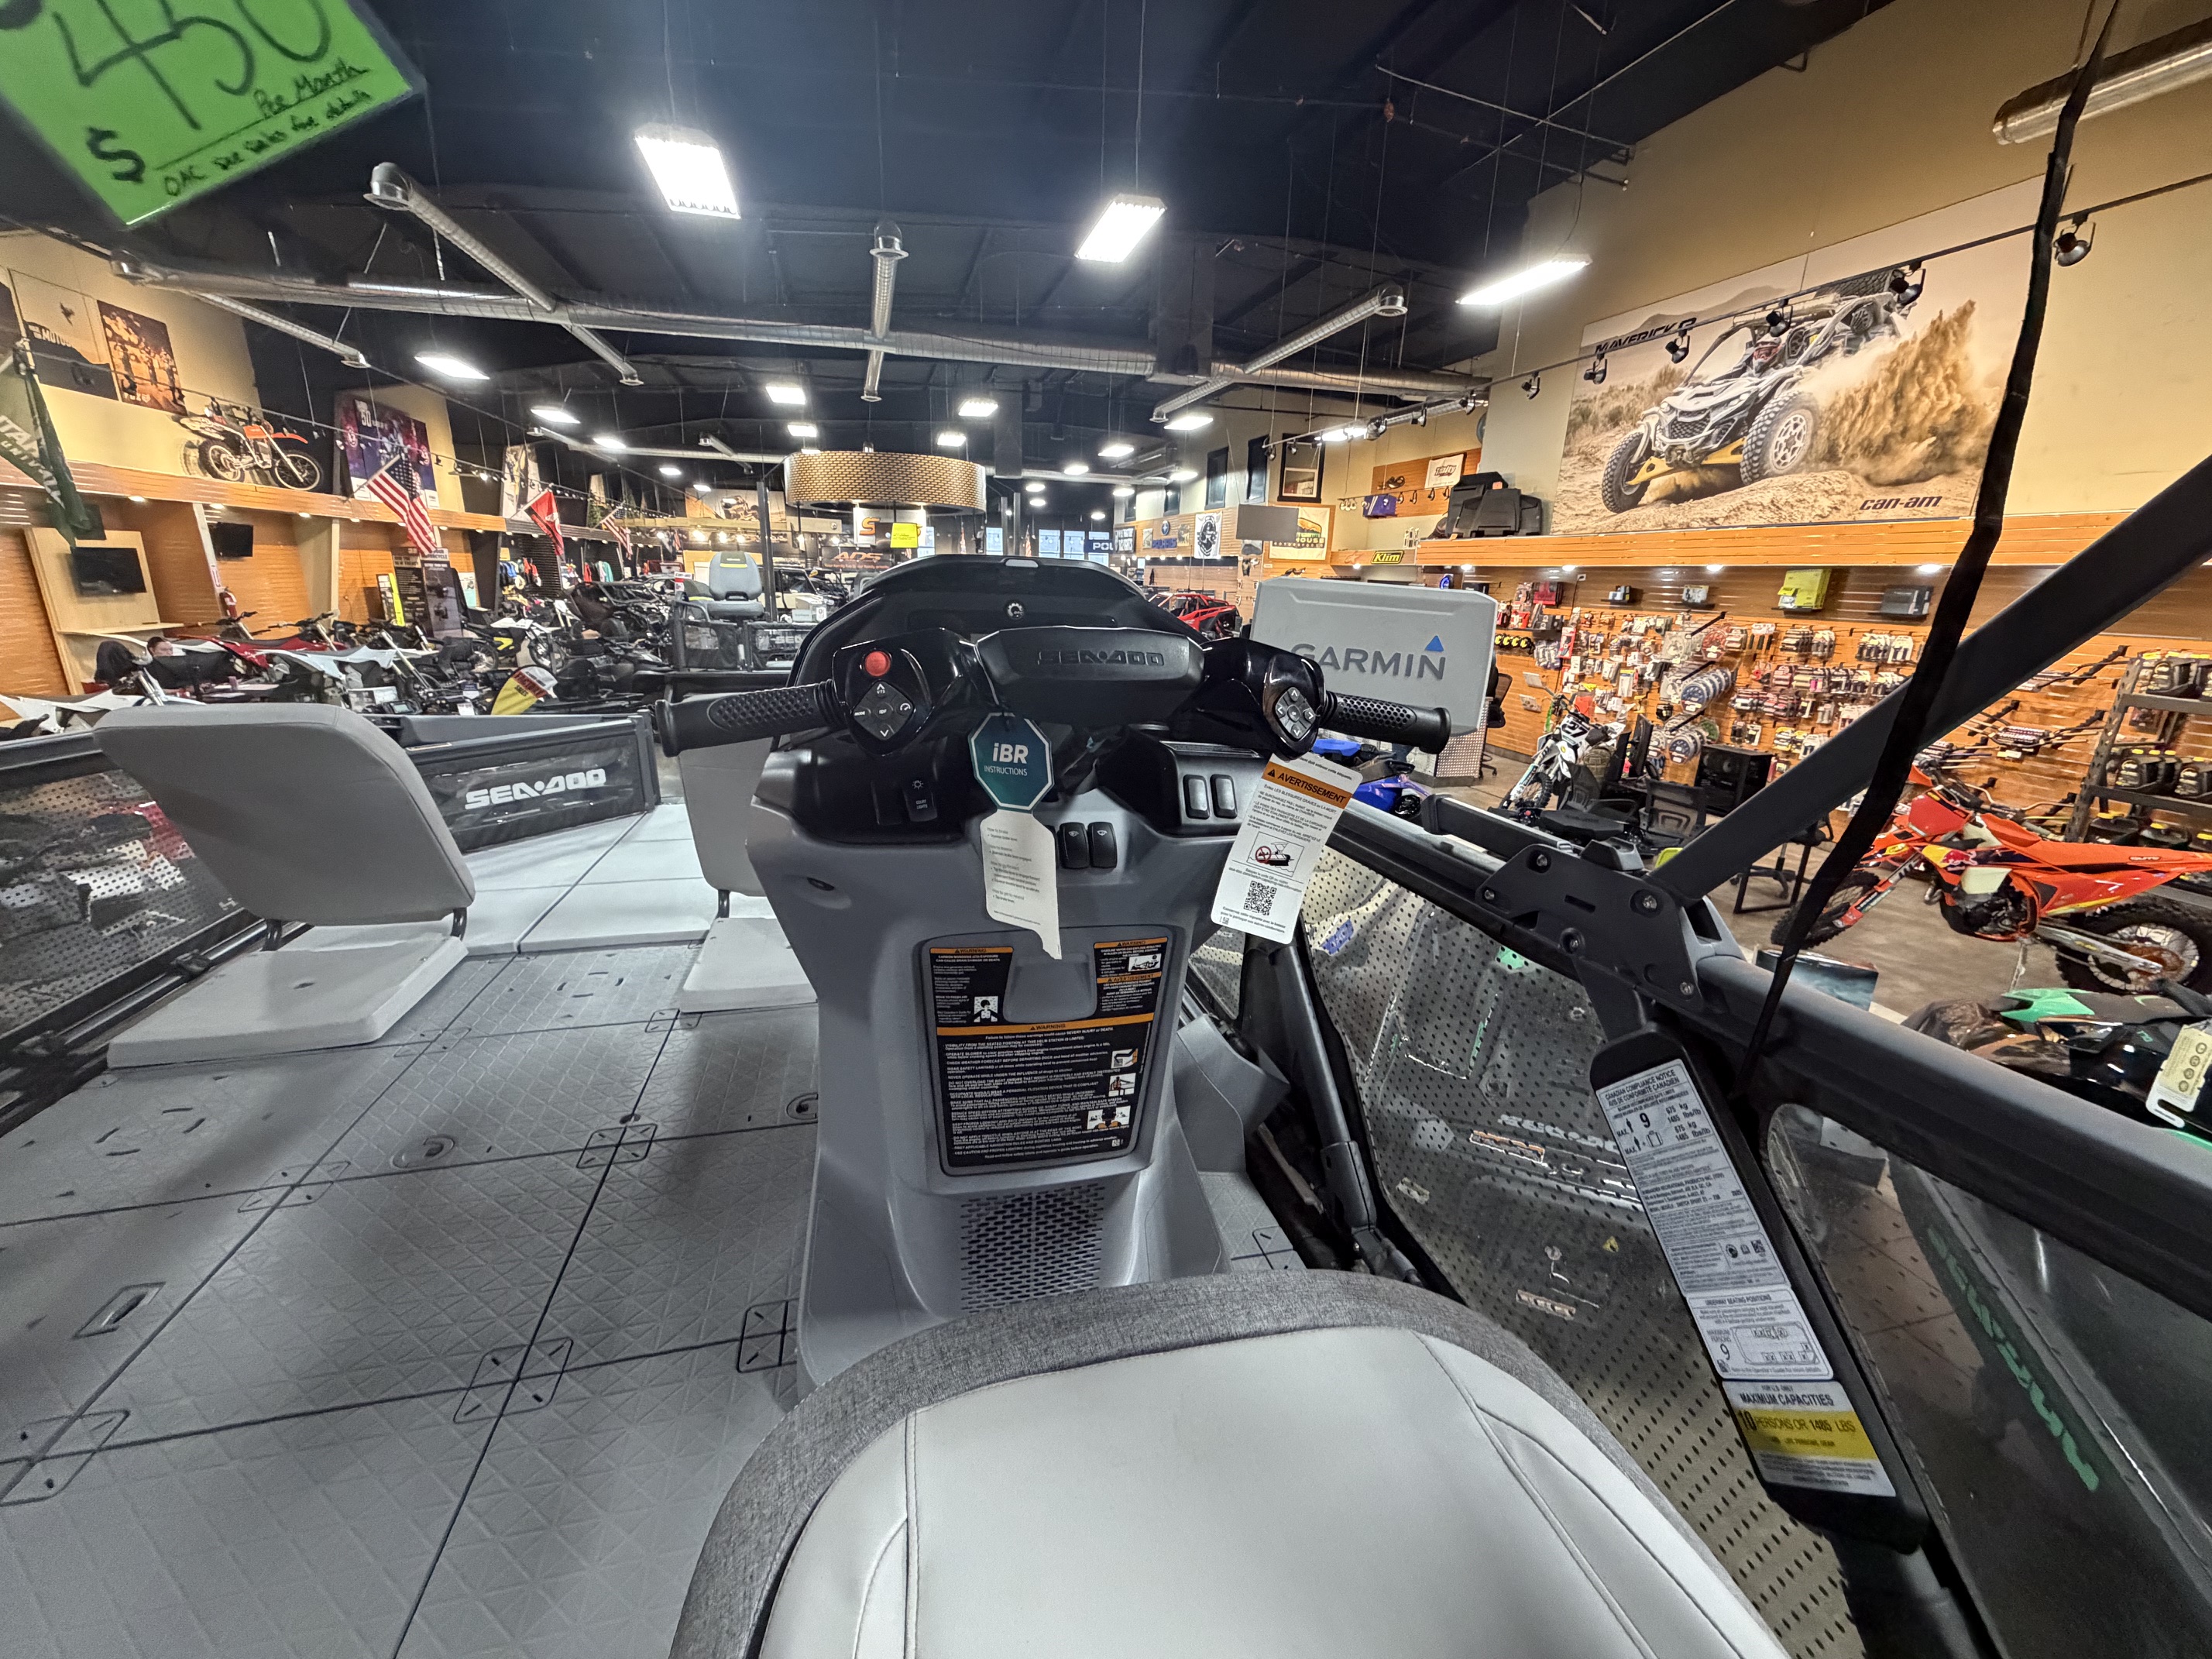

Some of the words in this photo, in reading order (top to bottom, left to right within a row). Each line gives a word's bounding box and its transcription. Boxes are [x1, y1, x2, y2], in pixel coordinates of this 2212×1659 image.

[294, 58, 370, 102] Month
[1291, 643, 1446, 680] GARMIN
[993, 743, 1029, 764] iBR
[984, 765, 1028, 776] INSTRUCTIONS
[1278, 772, 1346, 803] AVERTISSEMENT
[1605, 1088, 1625, 1099] CANADIAN
[1626, 1077, 1654, 1091] COMPLIANCE
[1655, 1070, 1674, 1080] NOTICE
[1652, 1077, 1678, 1090] CANADIEN
[1639, 1113, 1651, 1127] 9
[1688, 1120, 1696, 1128] kg
[1719, 1345, 1732, 1358] 9
[1740, 1393, 1777, 1403] MAXIMUM
[1778, 1394, 1833, 1406] CAPACITIES
[1755, 1417, 1793, 1428] PERSONS
[1791, 1418, 1808, 1430] OR
[1833, 1420, 1856, 1432] LBS
